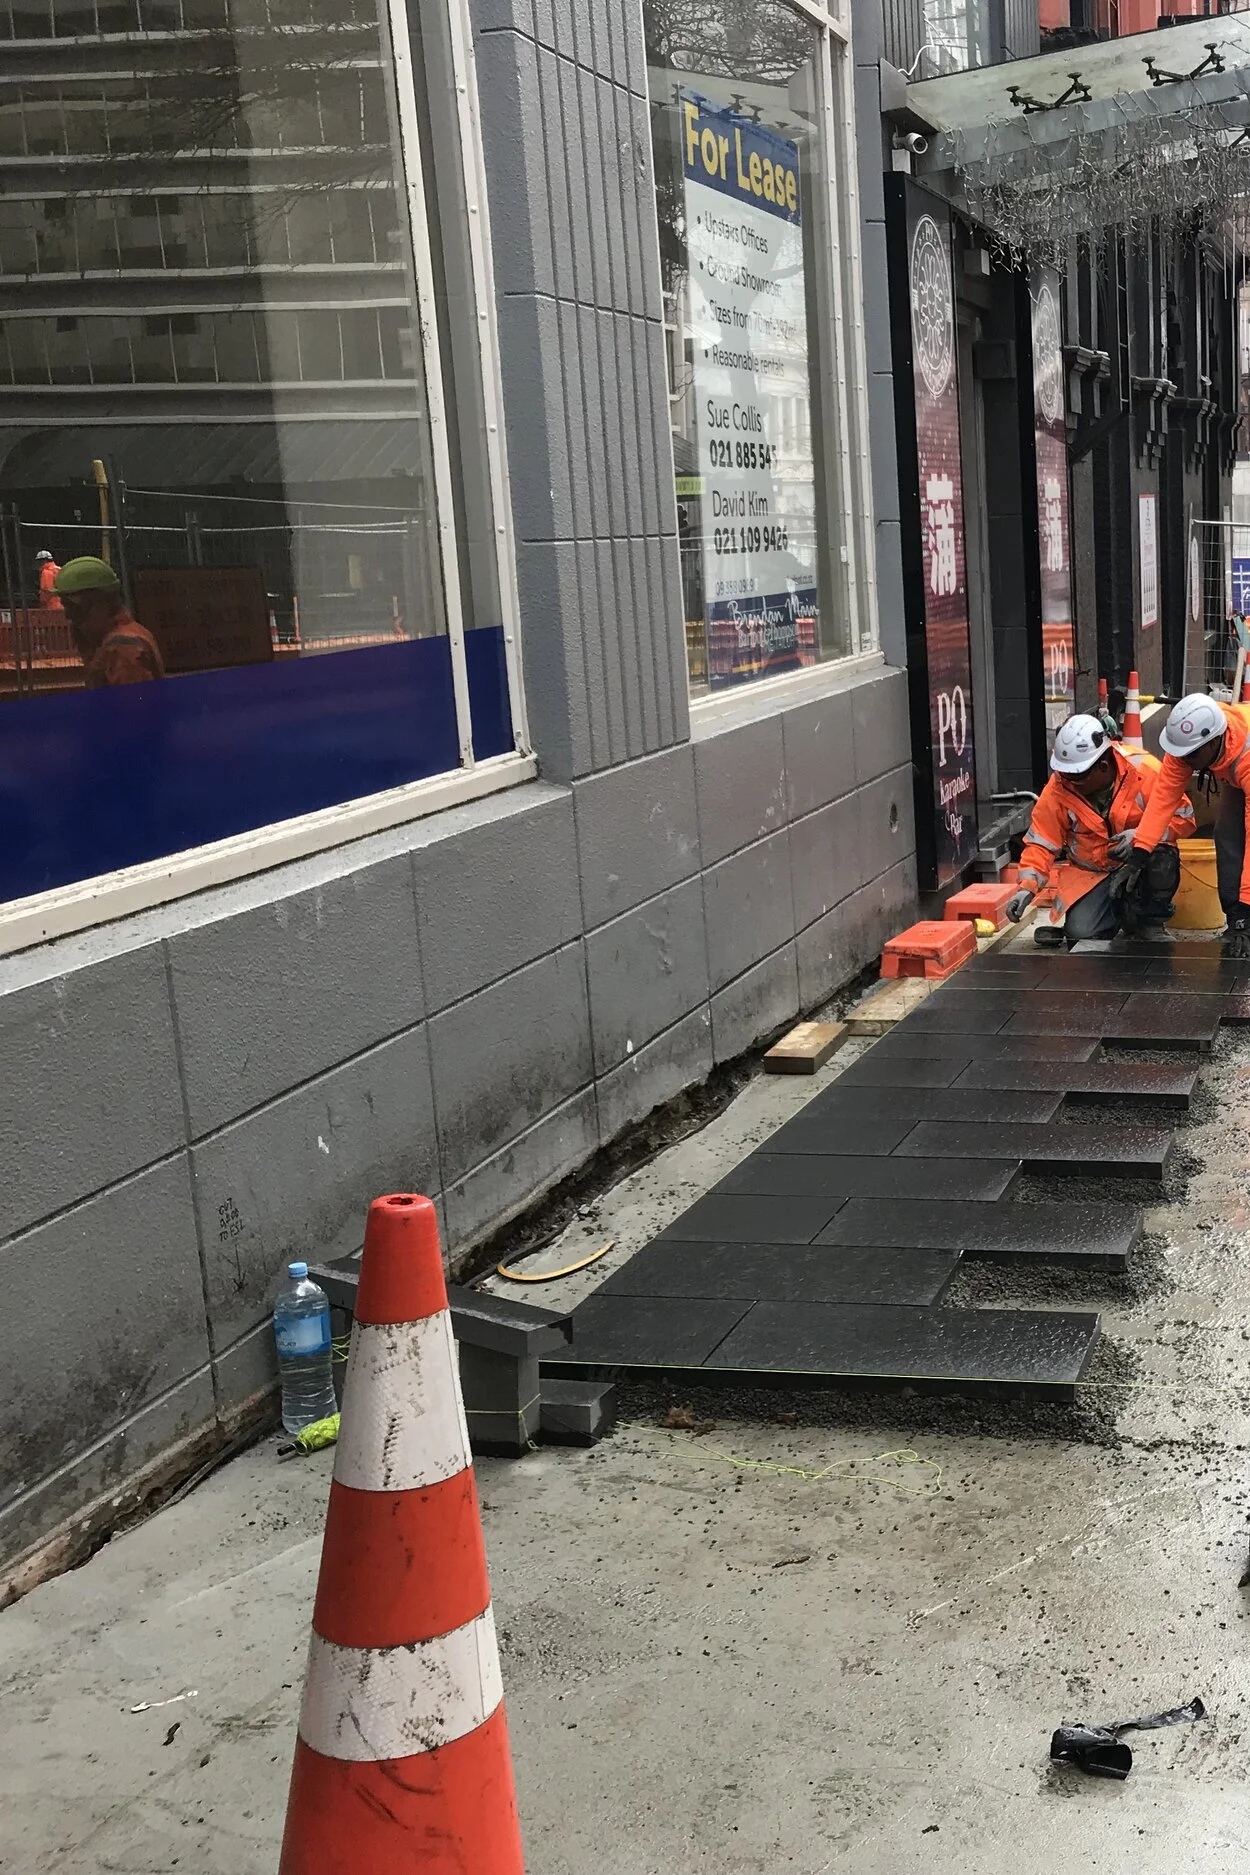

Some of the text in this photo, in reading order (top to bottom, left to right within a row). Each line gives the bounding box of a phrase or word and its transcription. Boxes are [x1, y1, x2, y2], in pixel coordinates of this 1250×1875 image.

[685, 102, 797, 212] For Lease
[704, 210, 769, 254] Upstairs Offices
[709, 299, 732, 325] Sizes
[712, 344, 785, 378] Reasonable rentals
[707, 399, 762, 433] Sue Collis
[709, 439, 734, 468] 021
[736, 441, 757, 469] 885
[712, 490, 769, 517] David Kim
[714, 527, 738, 555] 021
[740, 526, 761, 553] 109
[1050, 639, 1069, 701] PO
[937, 685, 967, 768] PO
[940, 767, 970, 806] karaoke
